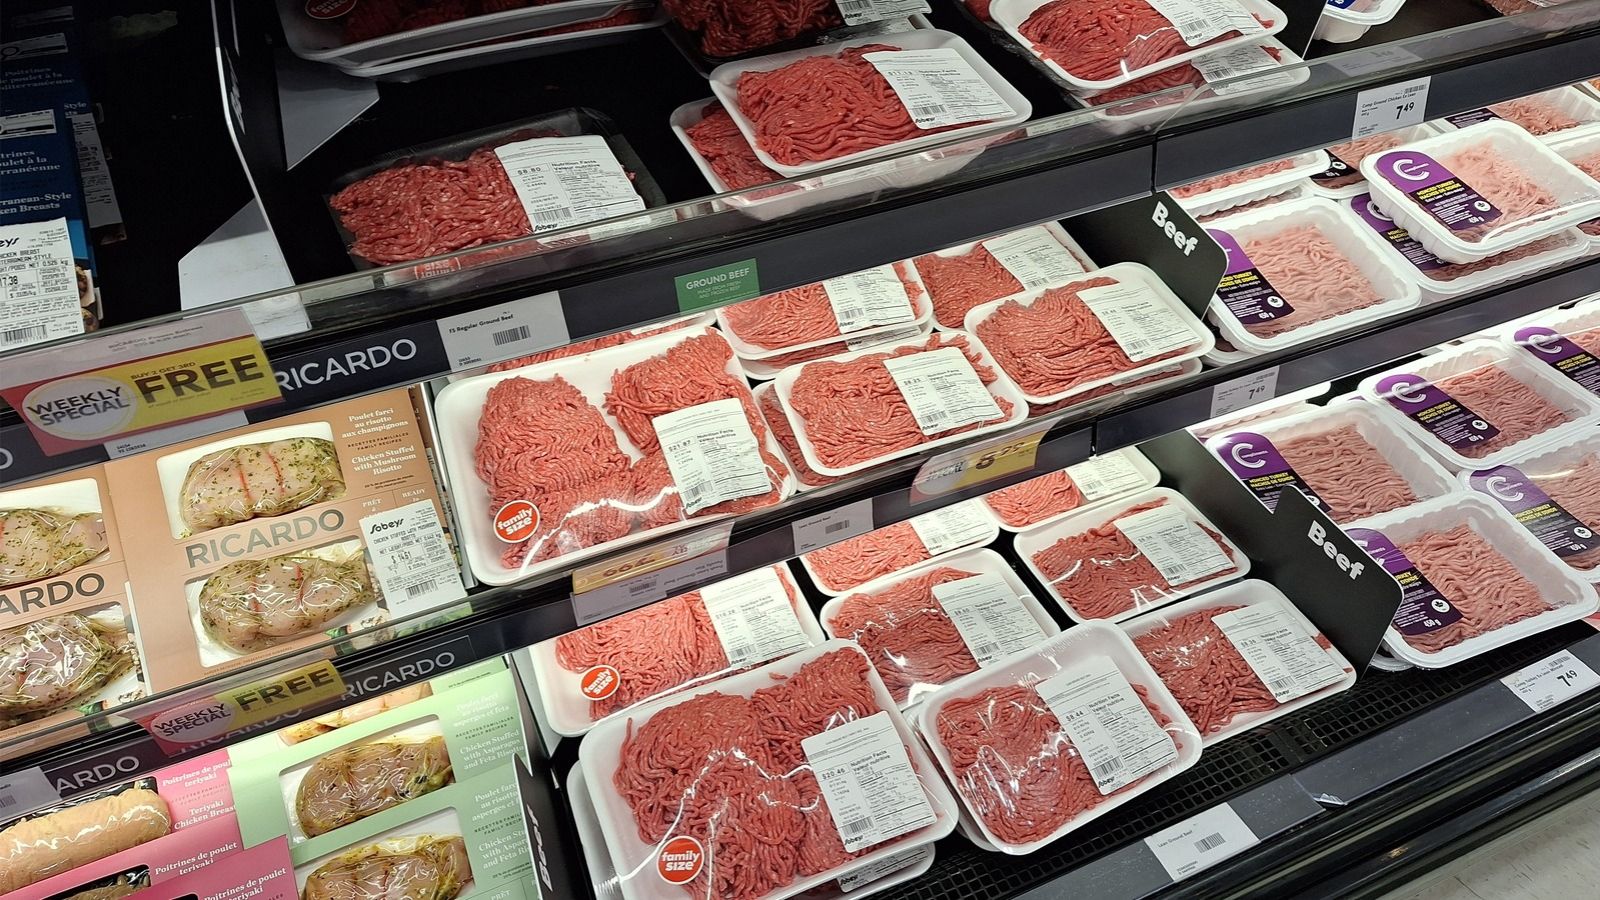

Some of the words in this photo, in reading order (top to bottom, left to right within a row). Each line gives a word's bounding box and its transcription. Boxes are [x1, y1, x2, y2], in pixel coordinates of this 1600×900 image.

[20, 203, 60, 213] Breasts
[1152, 201, 1198, 256] Beef
[686, 274, 726, 290] GROUND
[729, 268, 750, 280] BEEF
[457, 323, 478, 332] Regular
[479, 318, 500, 326] Ground
[131, 370, 150, 380] BUY
[158, 366, 176, 374] GET
[276, 338, 417, 392] RICARDO
[134, 354, 264, 404] FREE
[27, 386, 122, 416] WEEKLY
[40, 398, 131, 428] SPECIAL
[348, 412, 374, 422] Poulet
[376, 408, 394, 418] farci
[366, 416, 392, 426] risotto
[358, 420, 408, 436] champignons
[352, 452, 384, 464] Chicken
[386, 446, 415, 457] Stuffed
[354, 462, 372, 472] with
[373, 454, 416, 468] Mushroom
[373, 464, 402, 476] Risotto
[402, 488, 426, 498] READY
[370, 518, 404, 534] Sobeys
[498, 508, 533, 530] family
[506, 518, 532, 536] size
[185, 508, 345, 569] RICARDO
[1307, 520, 1365, 580] Beef
[340, 652, 455, 701] RICARDO
[585, 669, 610, 694] family
[595, 676, 613, 694] size
[233, 668, 335, 712] FREE
[154, 702, 226, 730] WEEKLY
[164, 710, 232, 737] SPECIAL
[460, 740, 491, 754] Chicken
[492, 730, 520, 743] Stuffed
[464, 752, 481, 761] with
[483, 739, 520, 754] Asparagus
[464, 761, 478, 770] and
[480, 755, 496, 765] Feta
[851, 756, 872, 766] Nutrition
[873, 750, 888, 758] Facts
[162, 770, 200, 787] Poitrines
[201, 766, 212, 774] de
[184, 772, 217, 788] teriyaki
[475, 788, 500, 802] Poulet
[189, 800, 224, 816] Teriyaki
[472, 805, 506, 822] asperges
[174, 814, 208, 830] Chicken
[478, 834, 512, 852] Chicken
[155, 858, 196, 876] Poitrines
[198, 852, 208, 861] de
[210, 842, 238, 857] poulet
[482, 846, 502, 859] with
[483, 860, 498, 870] and
[500, 852, 518, 864] Feta
[662, 850, 700, 862] family
[665, 861, 694, 871] size
[204, 882, 245, 900] Poitrines
[246, 878, 256, 888] de
[258, 868, 287, 882] poulet
